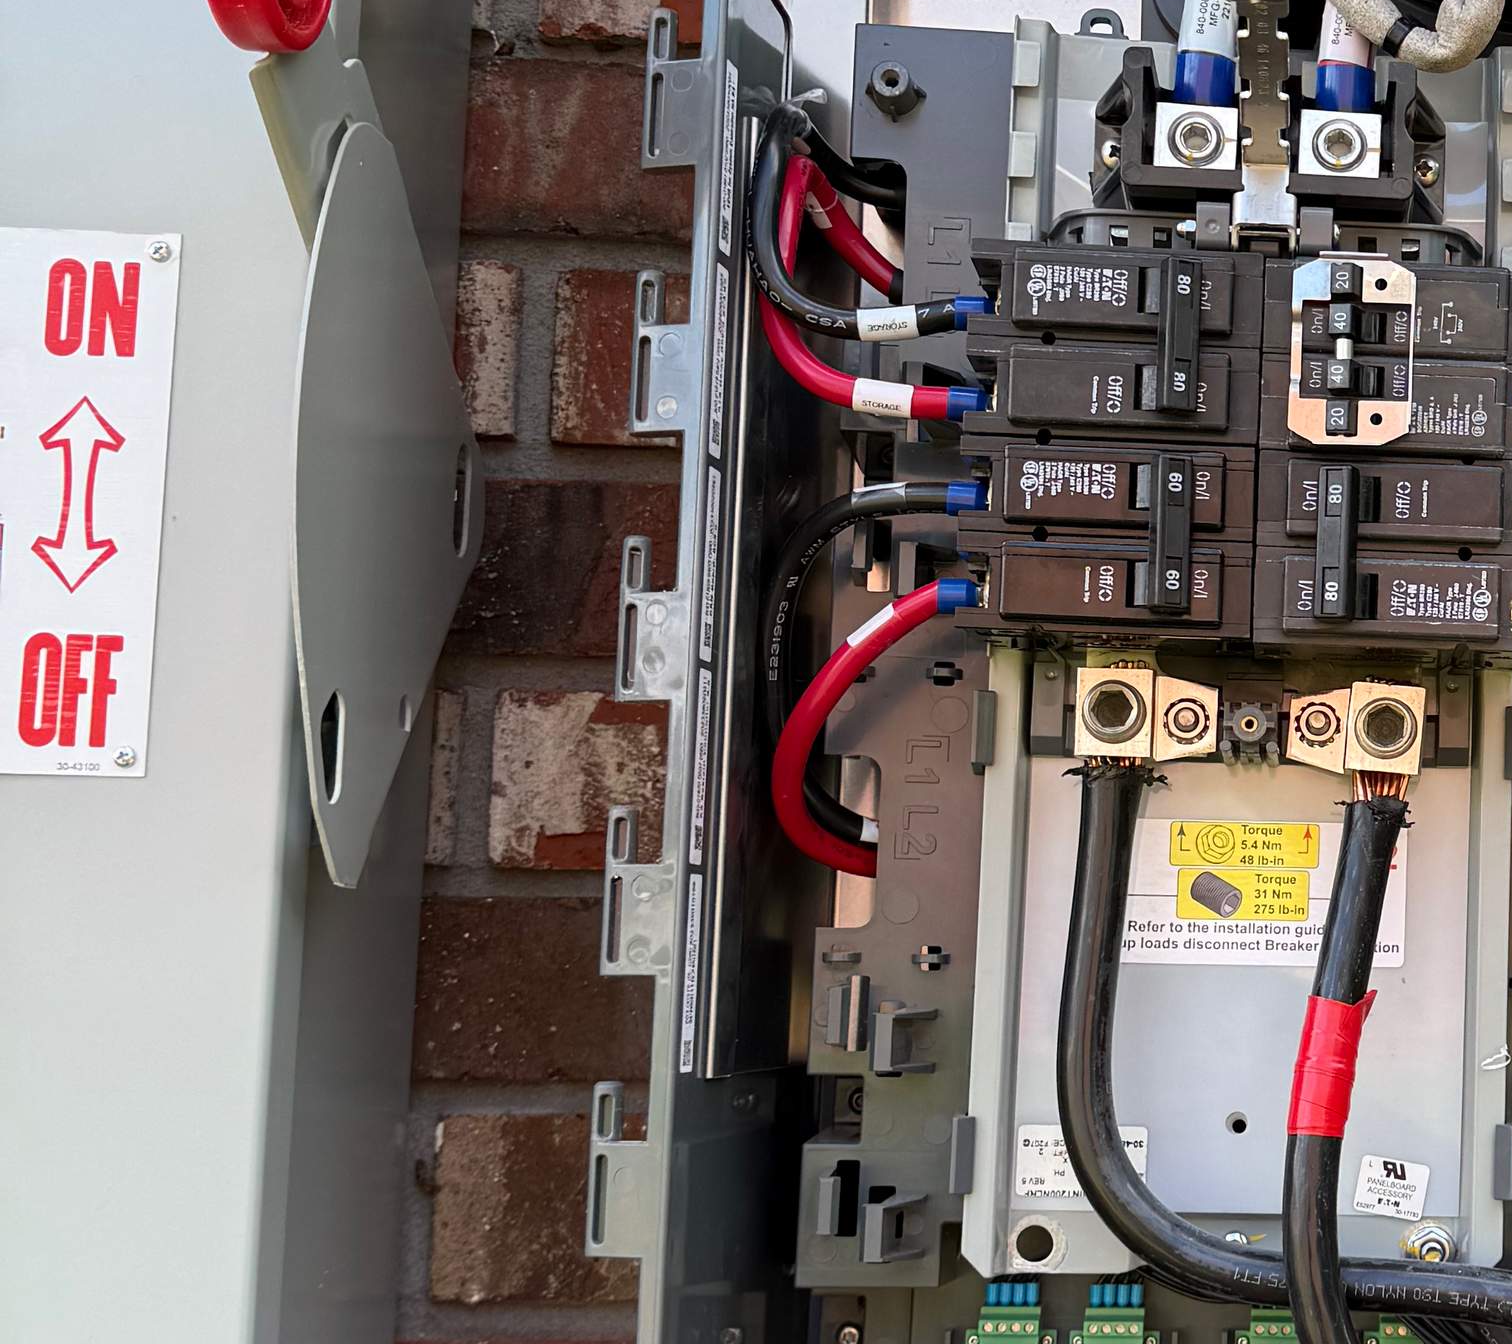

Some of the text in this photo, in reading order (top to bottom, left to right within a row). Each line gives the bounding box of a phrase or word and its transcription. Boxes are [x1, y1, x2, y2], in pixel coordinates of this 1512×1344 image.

[1112, 269, 1128, 307] Off/O
[1178, 274, 1191, 294] 80
[1336, 271, 1349, 289] 20
[44, 258, 142, 358] ON
[805, 313, 846, 329] CSA
[1334, 312, 1346, 330] 40
[1173, 372, 1186, 392] 80
[1335, 365, 1344, 383] 40
[1106, 375, 1123, 413] Off/O
[862, 400, 901, 410] STORAGE
[1331, 407, 1344, 425] 20
[1101, 464, 1116, 500] Off/O
[1168, 472, 1183, 492] 60
[1302, 480, 1317, 511] On/I
[1328, 484, 1343, 504] 80
[1395, 481, 1411, 519] Off/O
[1098, 565, 1114, 602] Off/O
[1166, 569, 1179, 590] 60
[1297, 580, 1313, 611] On/I
[1325, 582, 1339, 601] 80
[1390, 580, 1406, 617] Off/O
[769, 538, 825, 681] E231903 AWM
[18, 632, 125, 748] OFF
[1240, 825, 1283, 837] Torque
[1241, 840, 1282, 851] 5.4 Nm
[1240, 856, 1284, 866] 48 lb-in
[1255, 874, 1297, 886] Torque
[1254, 889, 1292, 900] 31 Nm
[1254, 905, 1305, 915] 275 lb-in
[1128, 920, 1290, 935] Refer to the installation
[1140, 938, 1319, 952] loads disconnect Breaker
[1367, 1177, 1416, 1192] PANELBOARD
[1367, 1186, 1413, 1200] ACCESSORY
[1410, 1287, 1442, 1305] T90
[1448, 1291, 1490, 1312] TYPE
